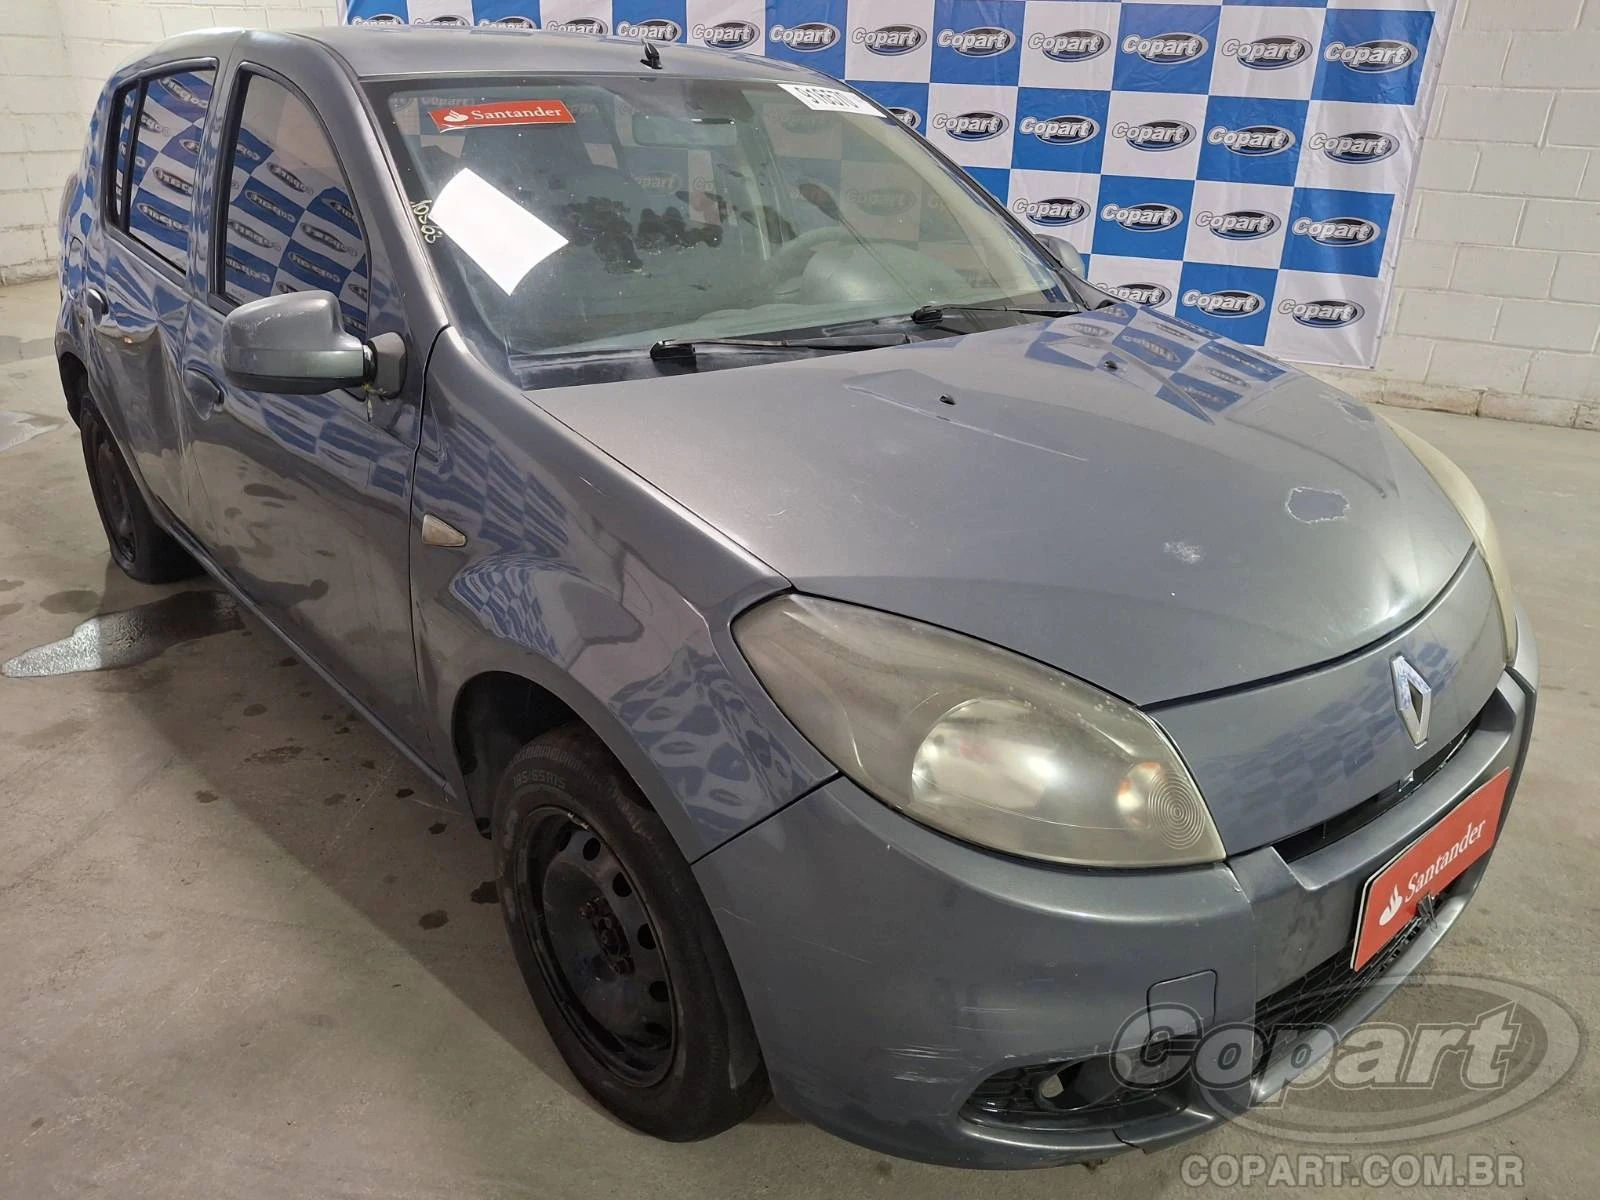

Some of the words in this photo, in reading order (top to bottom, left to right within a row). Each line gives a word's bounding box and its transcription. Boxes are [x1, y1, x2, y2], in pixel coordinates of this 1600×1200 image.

[617, 21, 675, 40] Copart
[692, 23, 751, 45] Copart
[769, 24, 833, 47] Copart
[851, 27, 919, 50] Copart
[937, 29, 1009, 53] Copart
[1028, 31, 1103, 56] Copart
[1122, 34, 1203, 60] Copart
[1222, 38, 1305, 65] Copart
[1323, 42, 1410, 69] Copart
[471, 107, 562, 121] Santander
[932, 112, 1005, 138] Copart
[1020, 117, 1094, 142] Copart
[1112, 120, 1190, 148] Copart
[1207, 126, 1290, 153] Copart
[1309, 133, 1391, 160] Copart
[1013, 198, 1084, 223] Copart
[1100, 203, 1177, 230] Copart
[1196, 210, 1274, 237] Copart
[1292, 217, 1374, 243] Copart
[1182, 289, 1258, 316] Copart
[1277, 298, 1359, 324] Copart
[1405, 818, 1486, 905] Santander
